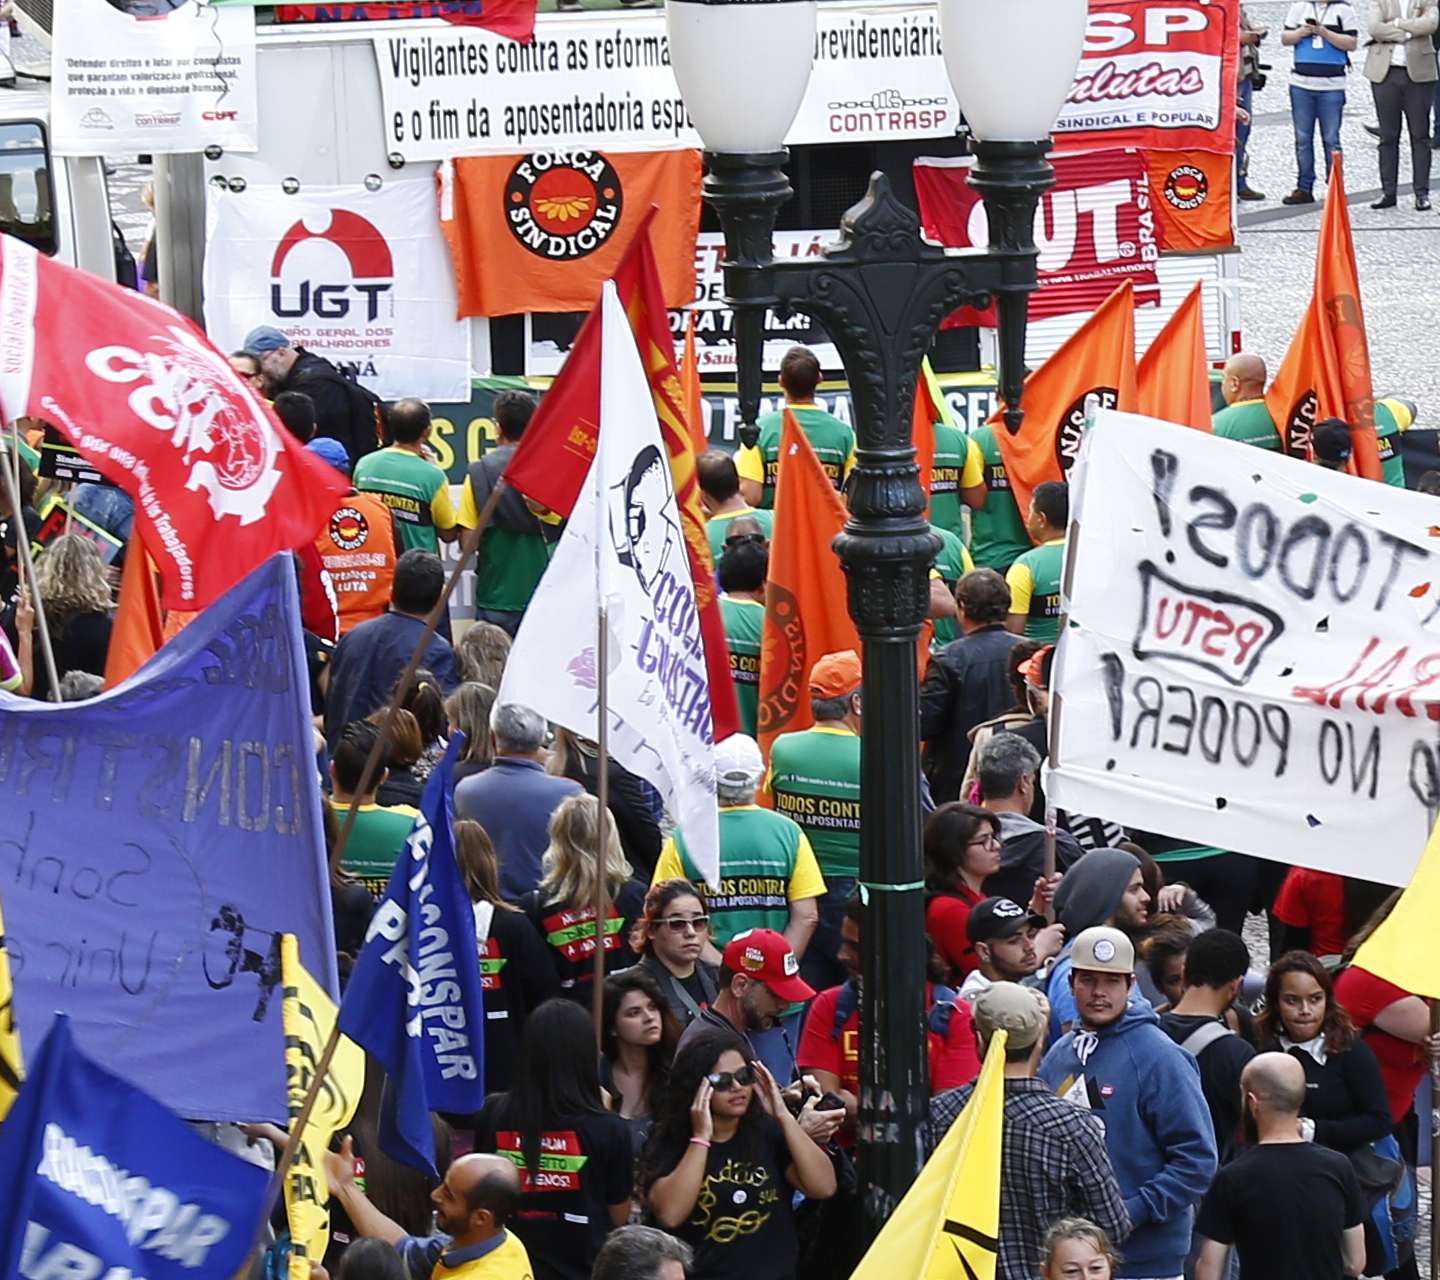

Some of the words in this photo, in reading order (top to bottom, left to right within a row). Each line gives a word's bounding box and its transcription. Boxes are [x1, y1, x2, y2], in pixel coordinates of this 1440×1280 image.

[388, 37, 490, 87] Vigilantes
[495, 37, 560, 75] contra
[566, 41, 589, 72] as
[392, 114, 405, 143] e
[413, 112, 425, 141] o
[428, 101, 460, 140] fim
[466, 100, 492, 139] da
[503, 92, 647, 146] aposentadoria
[829, 108, 949, 134] CONTRASP
[516, 146, 605, 183] FORÇA
[1168, 166, 1204, 184] FORÇA
[1164, 185, 1208, 212] SINDICAL
[507, 201, 617, 258] SINDICAL
[1137, 172, 1158, 268] BRASIL
[271, 281, 392, 322] UGT
[315, 326, 360, 339] GERAL
[363, 326, 394, 339] DOS
[776, 790, 815, 818] TODOS
[818, 795, 861, 821] CONT
[808, 813, 861, 831] APOSENTAD
[738, 878, 786, 894] CONTRA
